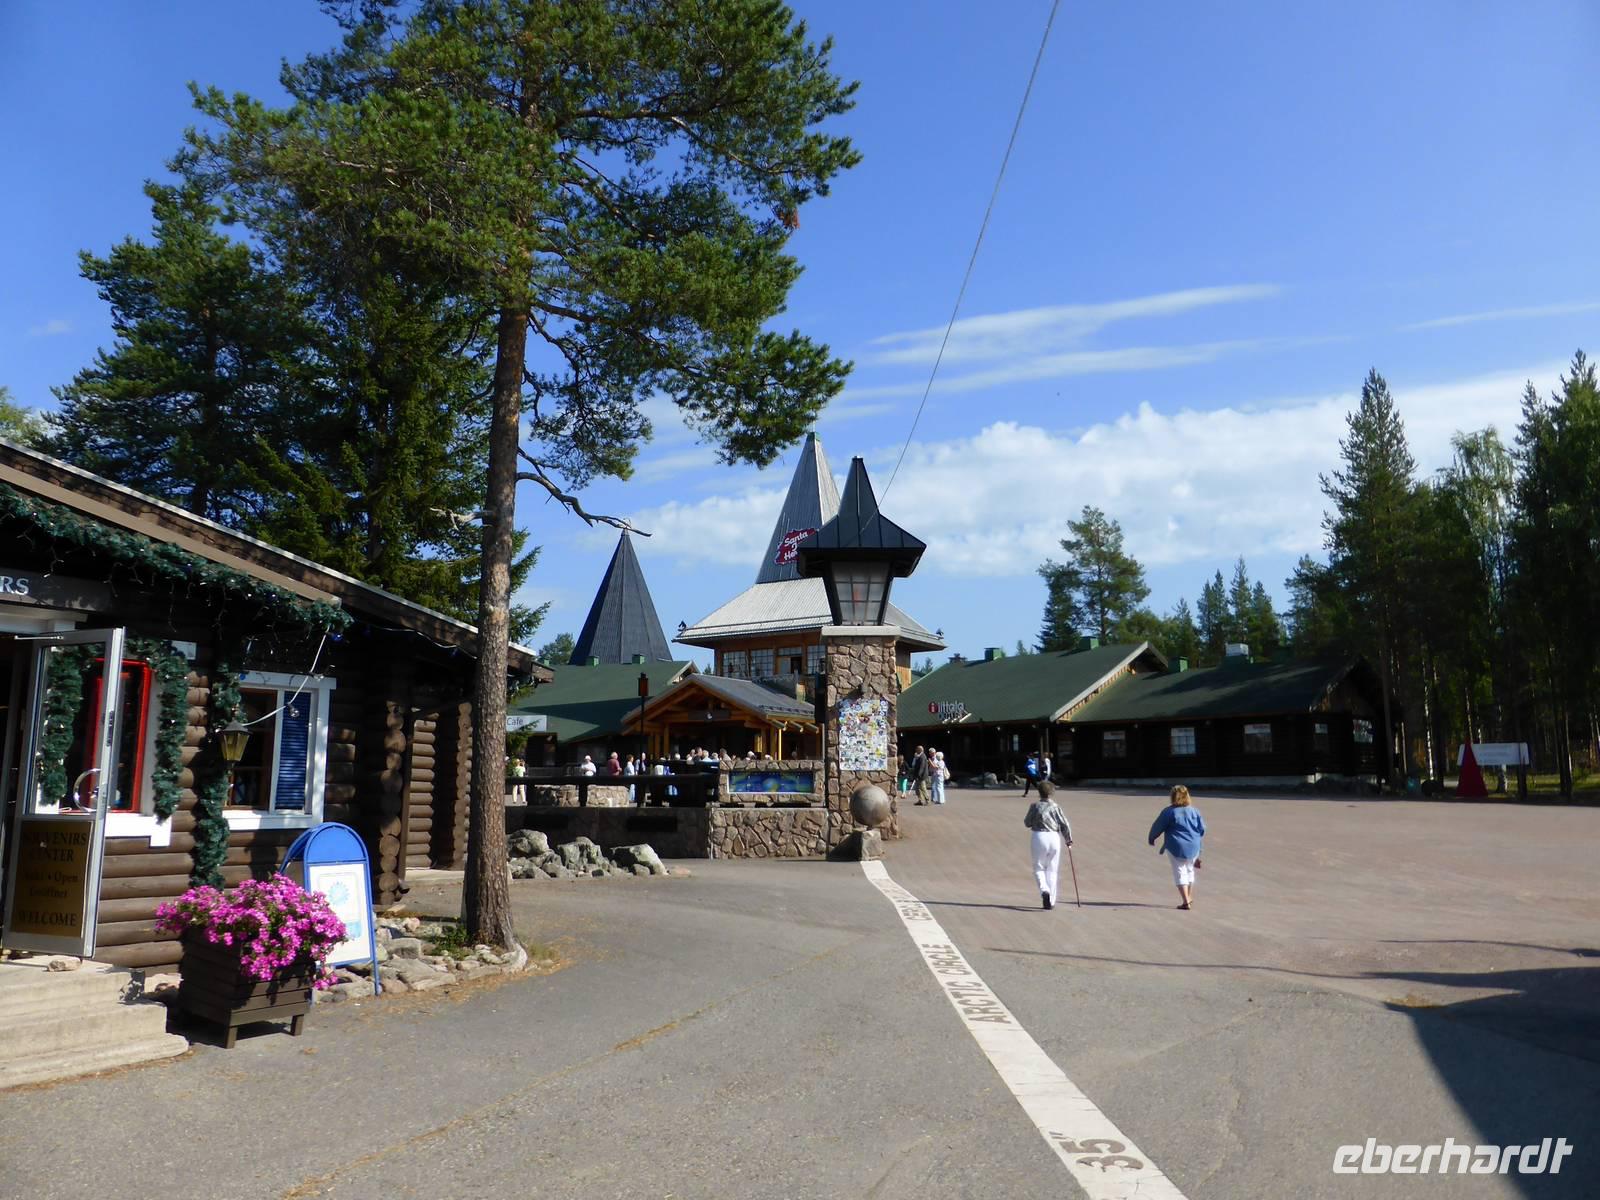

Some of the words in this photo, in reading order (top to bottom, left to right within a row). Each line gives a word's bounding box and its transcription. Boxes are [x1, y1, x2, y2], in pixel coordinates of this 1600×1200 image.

[784, 531, 809, 547] Santa
[17, 909, 77, 928] WELCOME
[921, 943, 972, 976] CIRCLE
[945, 981, 1013, 1024] ARCTIC
